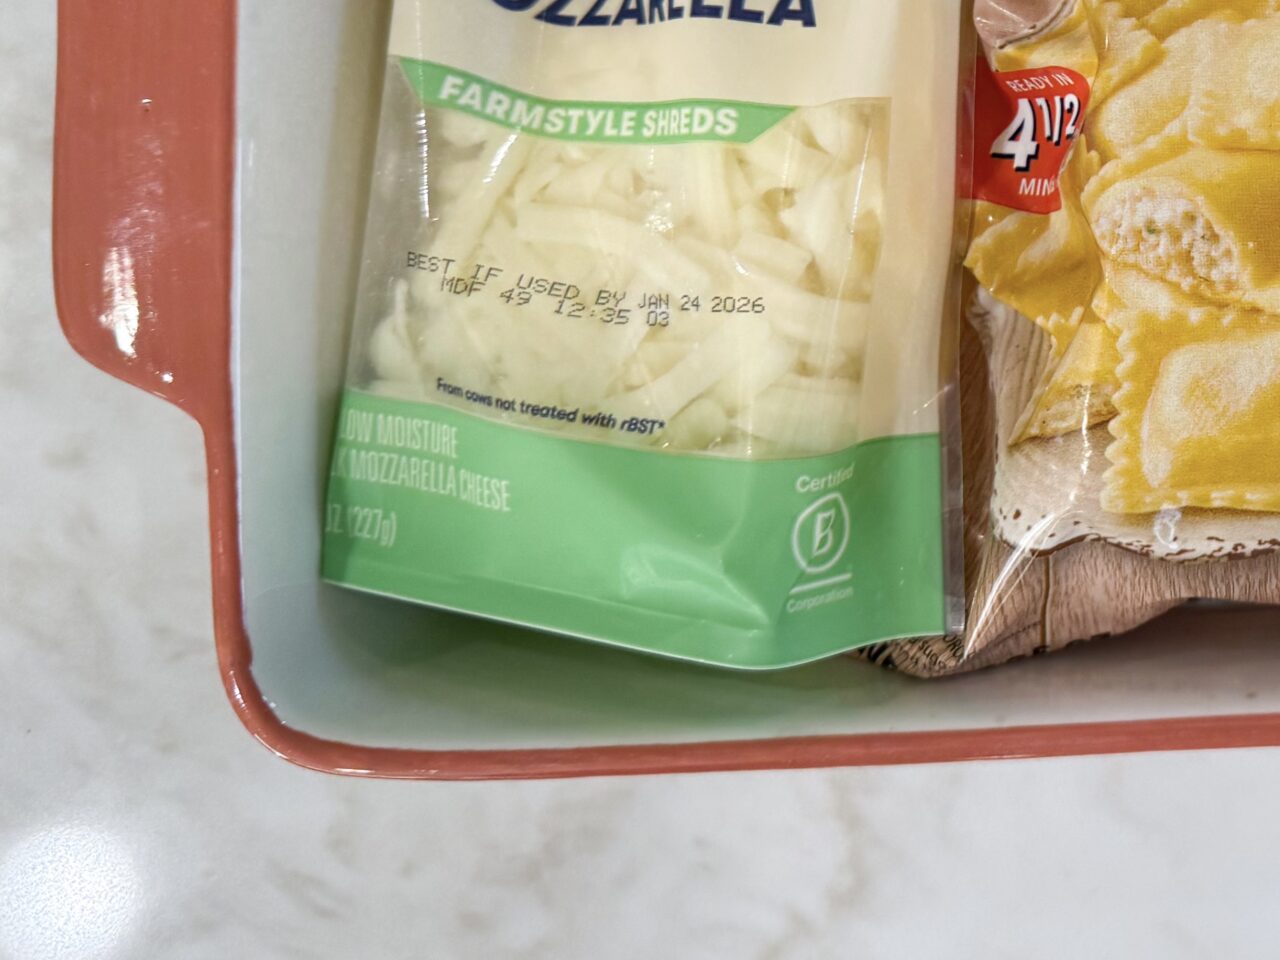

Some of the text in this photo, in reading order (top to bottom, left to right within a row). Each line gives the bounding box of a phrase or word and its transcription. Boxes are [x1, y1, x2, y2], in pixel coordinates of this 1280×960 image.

[440, 75, 738, 137] FARMSTYLE SHREDS
[1006, 72, 1075, 93] READY IN
[407, 252, 765, 313] BEST IF USED BY JAN 24 2026
[500, 289, 532, 306] 49
[553, 300, 632, 326] 12:35
[646, 310, 670, 328] 03
[436, 378, 463, 397] From
[465, 391, 493, 407] cows
[495, 397, 516, 412] not
[520, 400, 580, 423] treated
[582, 412, 616, 430] with
[376, 413, 459, 459] MOISTURE
[350, 449, 457, 497] MOZZARELLA
[459, 469, 511, 512] CHEESE
[786, 587, 853, 613] Corporation
